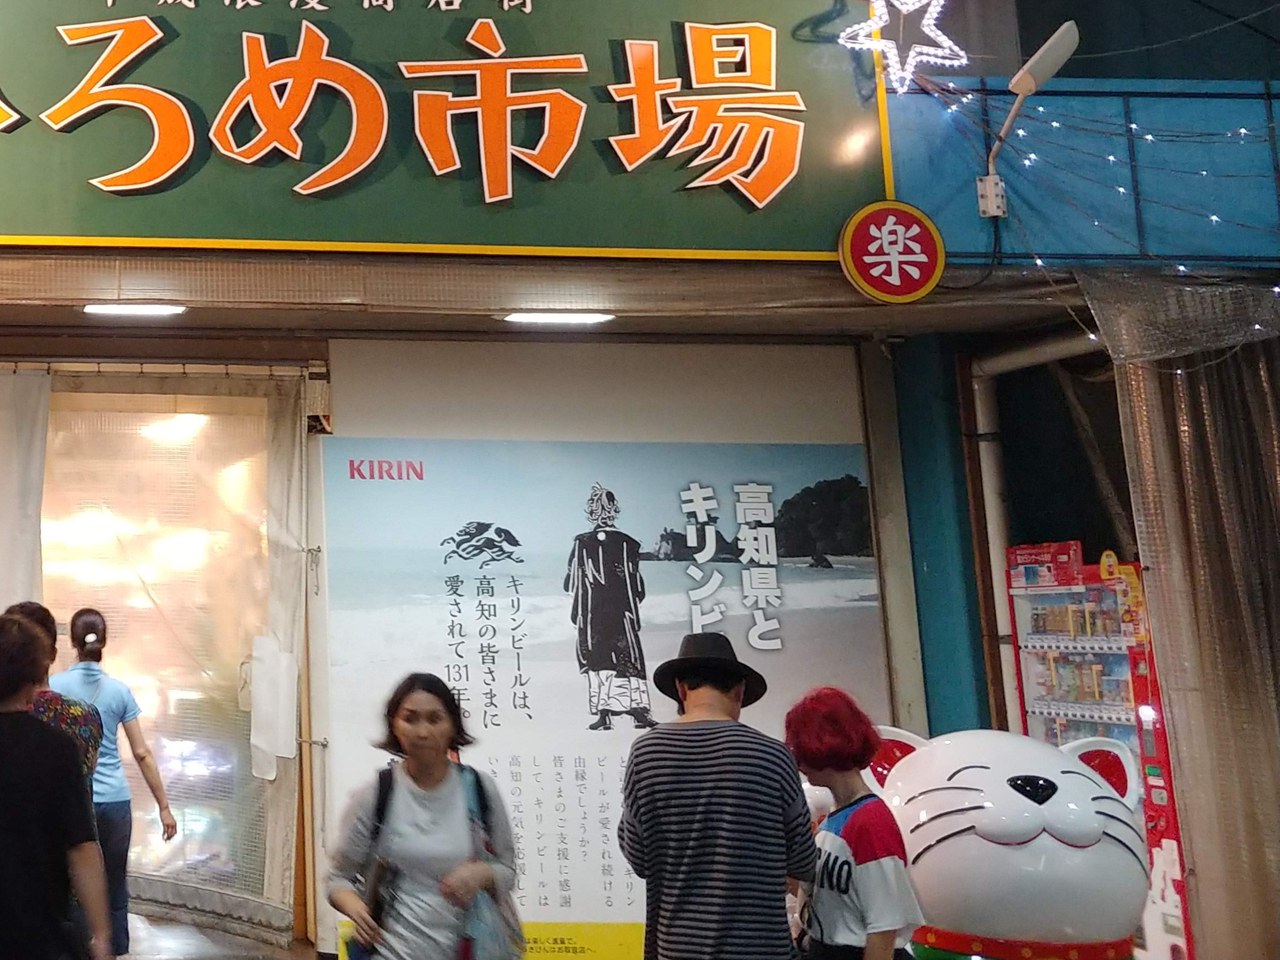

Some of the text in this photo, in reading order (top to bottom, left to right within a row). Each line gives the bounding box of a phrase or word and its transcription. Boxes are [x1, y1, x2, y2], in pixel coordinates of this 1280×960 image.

[862, 220, 928, 287] 楽
[348, 459, 425, 481] KIRIN
[733, 482, 783, 650] 高知県と
[474, 575, 501, 729] 高知の皆さまに
[506, 575, 533, 720] キリンビールは、
